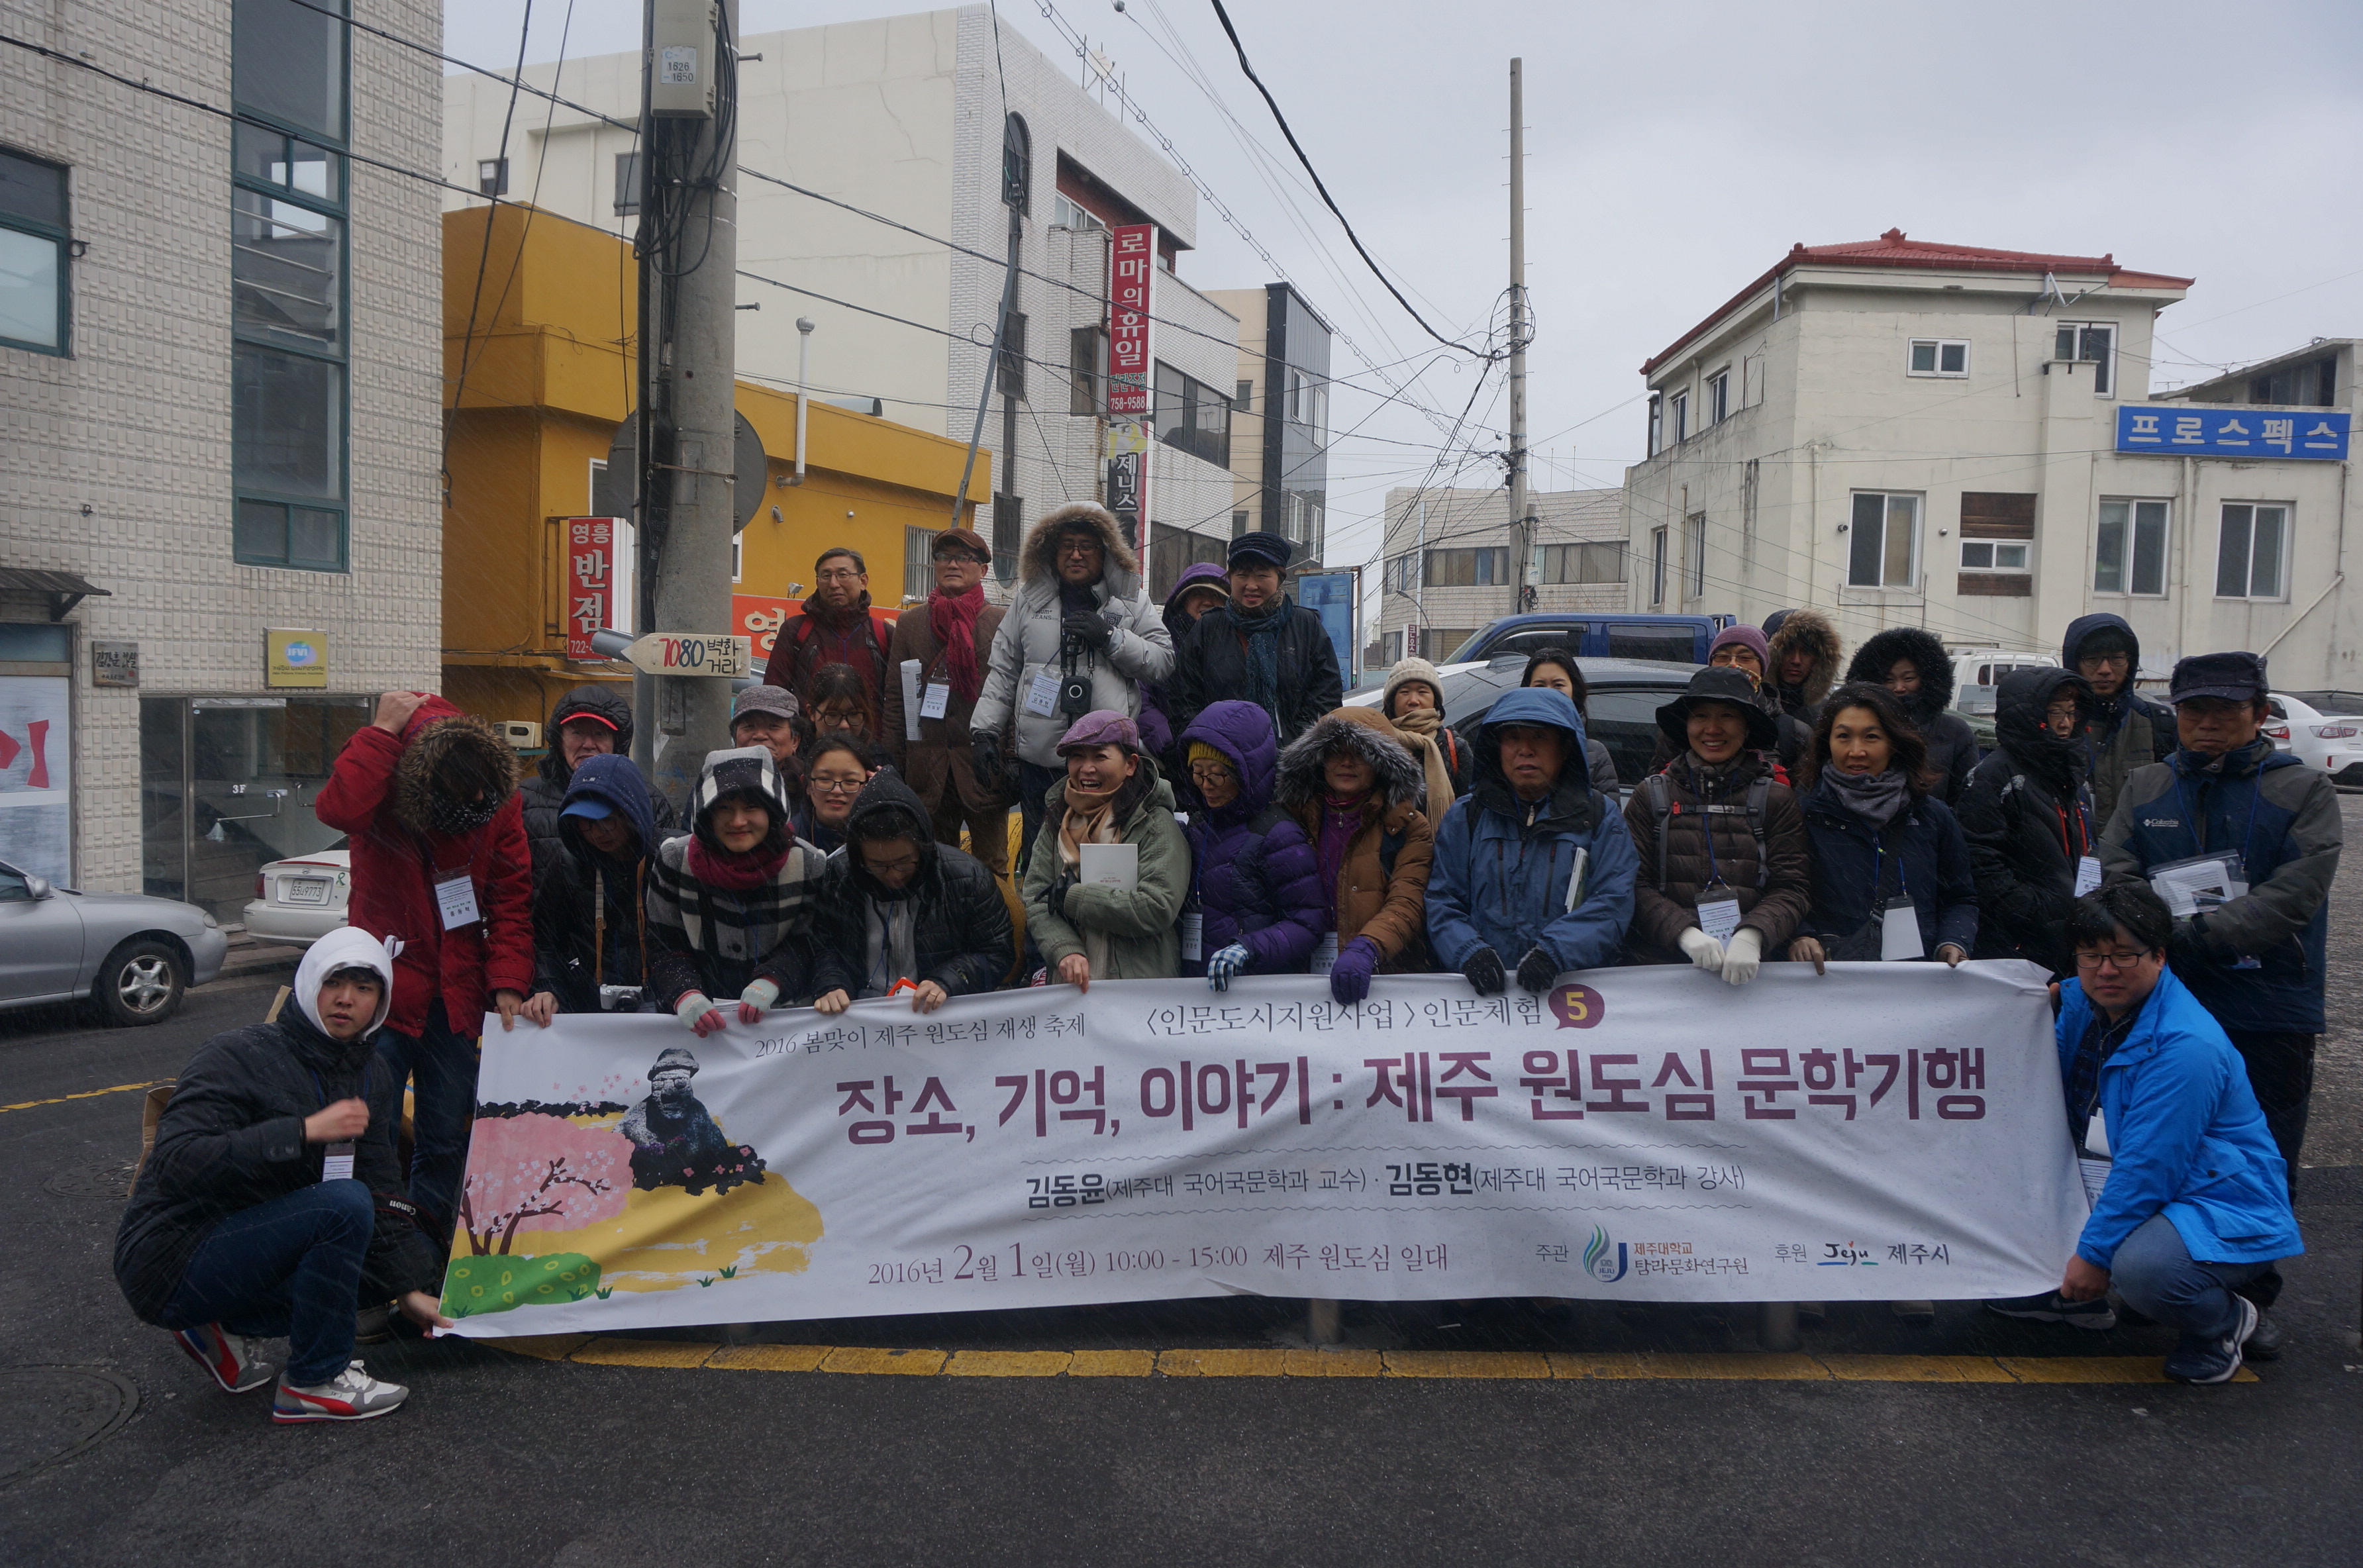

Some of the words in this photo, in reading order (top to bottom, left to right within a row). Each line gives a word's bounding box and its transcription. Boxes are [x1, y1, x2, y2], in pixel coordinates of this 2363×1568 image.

[668, 62, 689, 71] 1626
[673, 72, 693, 81] 1650
[1111, 396, 1146, 409] 758-9588
[2128, 415, 2338, 454] 프로스펙스
[572, 523, 611, 544] 영흥
[572, 549, 611, 634] 반점
[659, 638, 705, 667] 7080
[707, 638, 739, 656] 벽화
[706, 658, 736, 674] 거리
[232, 784, 247, 794] 3F
[1424, 995, 1541, 1028] 인문체험
[1567, 991, 1588, 1020] 5
[755, 1033, 797, 1058] 2016
[802, 1026, 866, 1054] 봄맞이
[874, 1024, 918, 1047] 제주
[925, 1020, 988, 1044] 원도심
[996, 1016, 1036, 1041] 재생
[1044, 1012, 1085, 1037] 축제
[836, 1075, 975, 1144] 장소,
[995, 1065, 1121, 1137] 기억,
[1140, 1055, 1311, 1131] 이야기
[1364, 1051, 1498, 1122] 제주
[1519, 1049, 1716, 1120] 원도심
[1737, 1048, 1986, 1120] 문학기행
[1183, 1168, 1309, 1196] 국어국문학과
[1318, 1167, 1366, 1191] 교수)
[1556, 1165, 1687, 1191] 국어국문학과
[1697, 1165, 1745, 1191] 강사)
[389, 1200, 417, 1216] Canon
[1535, 1244, 1569, 1263] 주관
[1634, 1242, 1693, 1255] 제주대학교
[1774, 1243, 1808, 1263] 후원
[1823, 1242, 1870, 1266] Jeju
[1887, 1244, 1950, 1266] 제주시
[868, 1258, 944, 1285] 2016년
[953, 1244, 998, 1281] 2월
[1009, 1242, 1096, 1279] 1일(월)
[1107, 1249, 1164, 1271] 10:00
[1189, 1246, 1248, 1268] 15:00
[1263, 1242, 1311, 1271] 제주
[1318, 1244, 1390, 1273] 원도심
[1400, 1243, 1448, 1272] 일대
[1634, 1257, 1750, 1276] 탐라문화연구원
